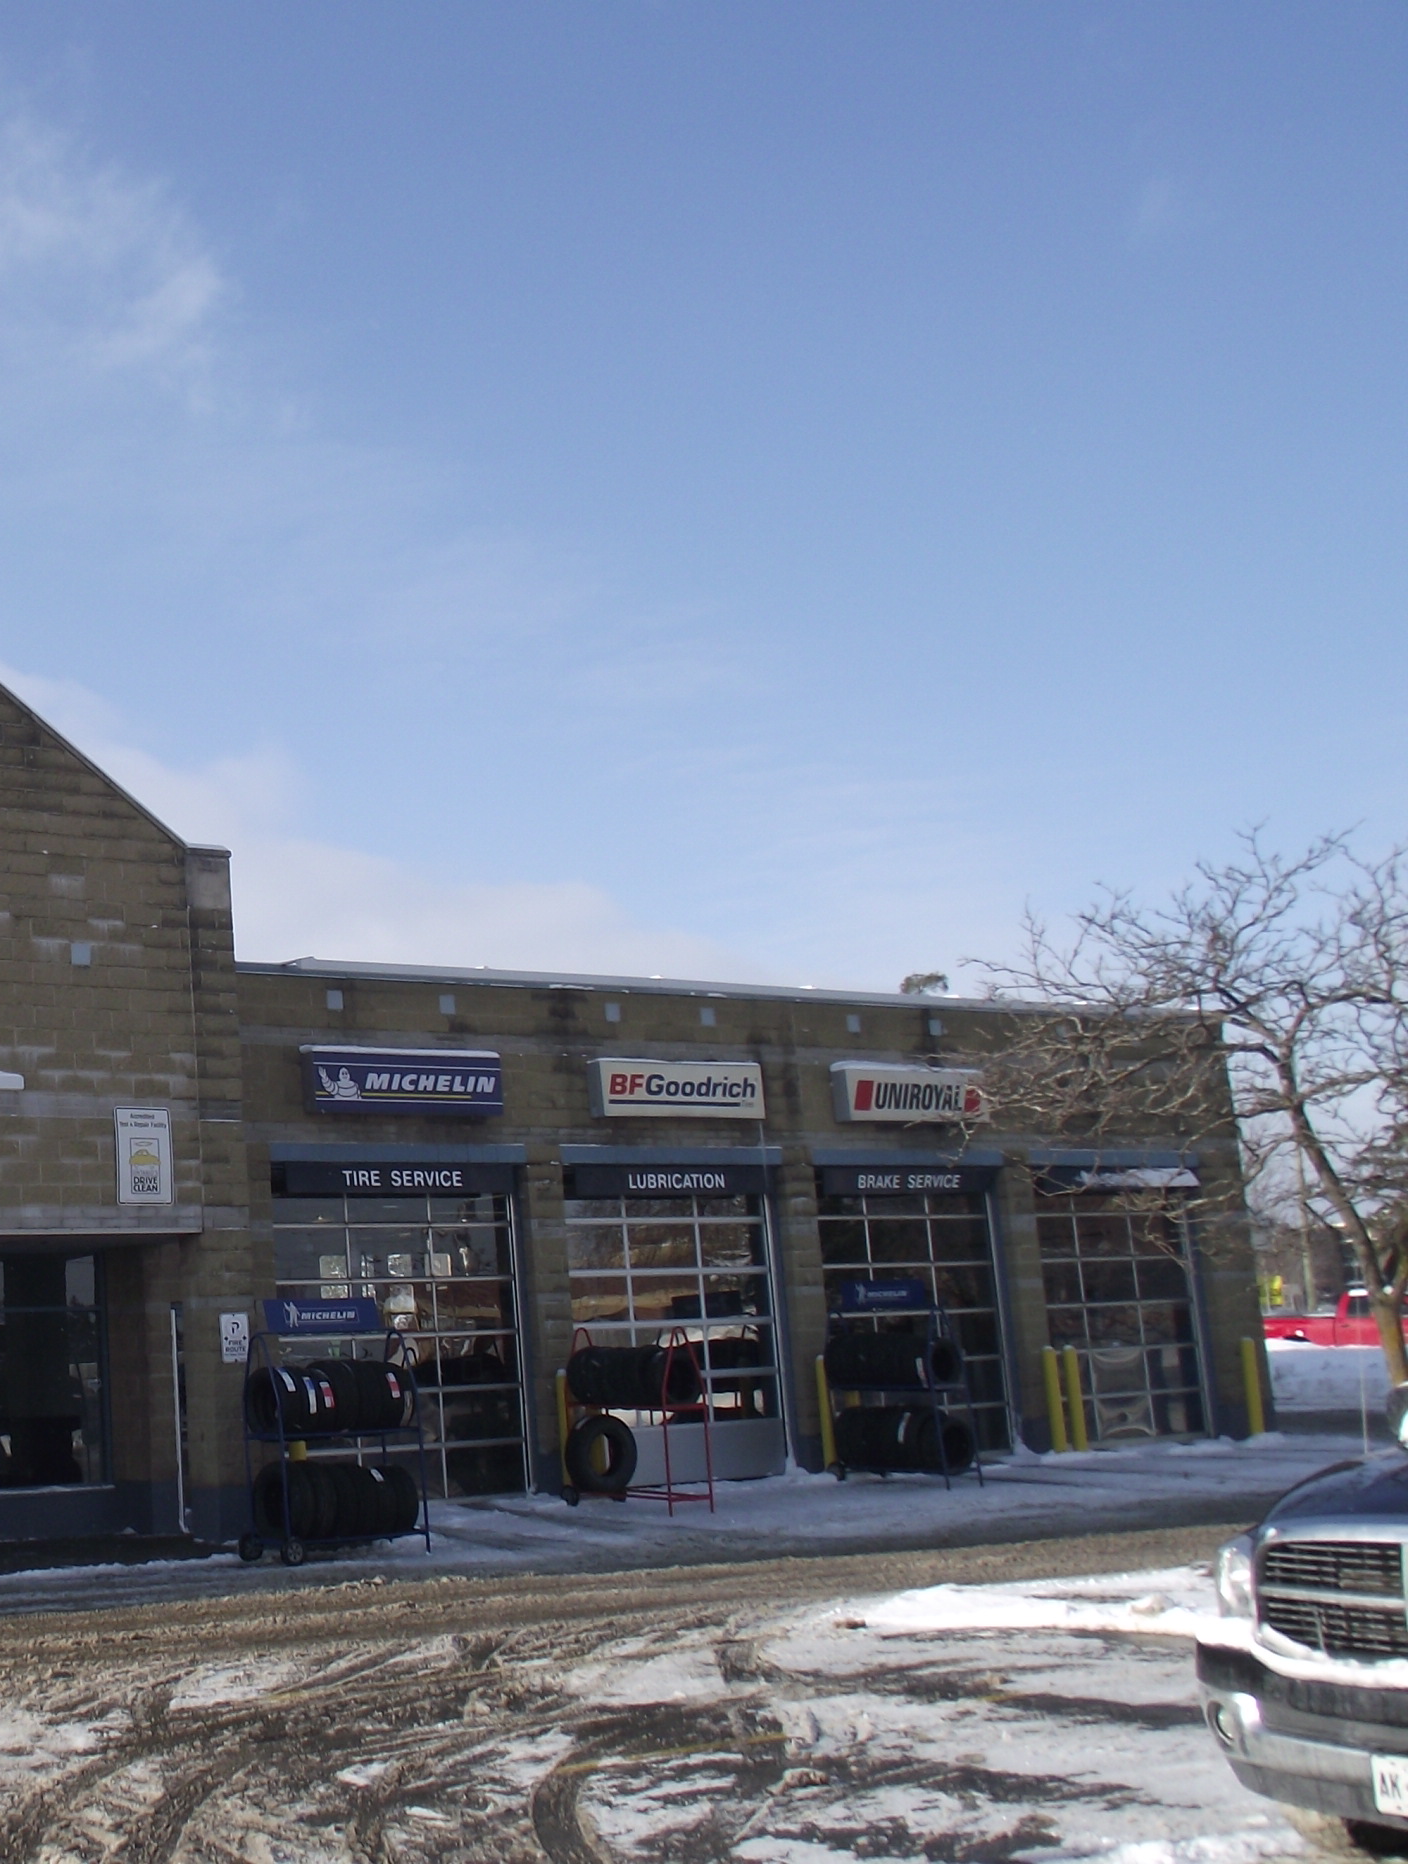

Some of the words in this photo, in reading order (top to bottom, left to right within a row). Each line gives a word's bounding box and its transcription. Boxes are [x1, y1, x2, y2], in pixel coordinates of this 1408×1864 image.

[364, 1072, 496, 1094] MICHELIN
[608, 1073, 756, 1099] BFGoodrich
[874, 1082, 963, 1112] UNIROYAL
[133, 1176, 158, 1185] DRIVE
[342, 1170, 381, 1187] TIRE
[391, 1170, 463, 1188] SERVICE
[628, 1173, 726, 1190] LUBRICATION
[857, 1174, 900, 1189] BRAKE
[907, 1174, 962, 1190] SERVICE
[301, 1310, 356, 1320] MICHELIN
